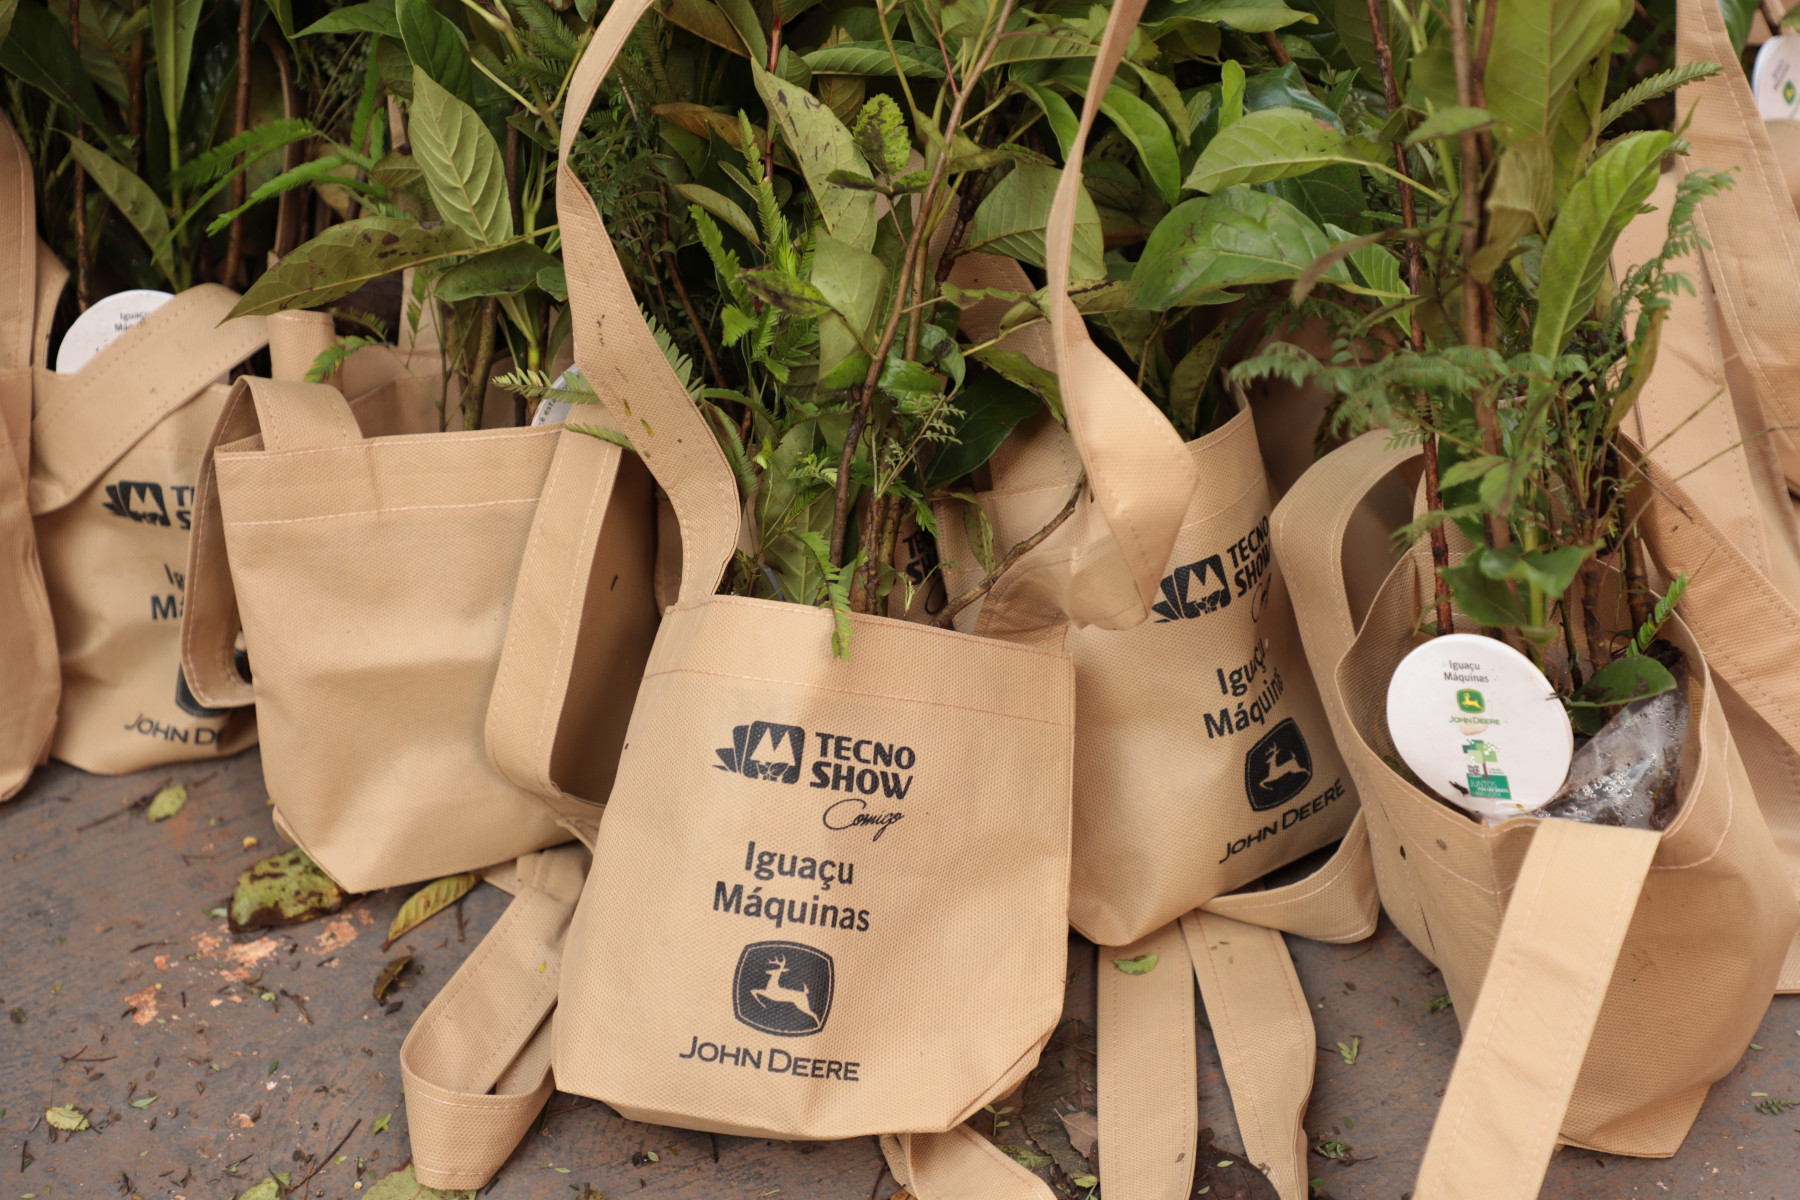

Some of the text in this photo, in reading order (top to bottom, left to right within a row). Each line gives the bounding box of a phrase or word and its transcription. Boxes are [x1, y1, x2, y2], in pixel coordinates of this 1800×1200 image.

[1227, 515, 1270, 568] TECNO
[1444, 672, 1489, 683] Máquinas
[1449, 659, 1480, 672] Iguaçu
[124, 713, 188, 743] JOHN
[815, 731, 916, 770] TECNO
[810, 762, 913, 800] SHOW
[822, 798, 904, 842] Comigo
[1219, 777, 1345, 864] JOHN DEERE
[745, 840, 855, 890] Iguaçu
[712, 880, 870, 932] Máquinas
[679, 1035, 860, 1082] JOHN DEERE
